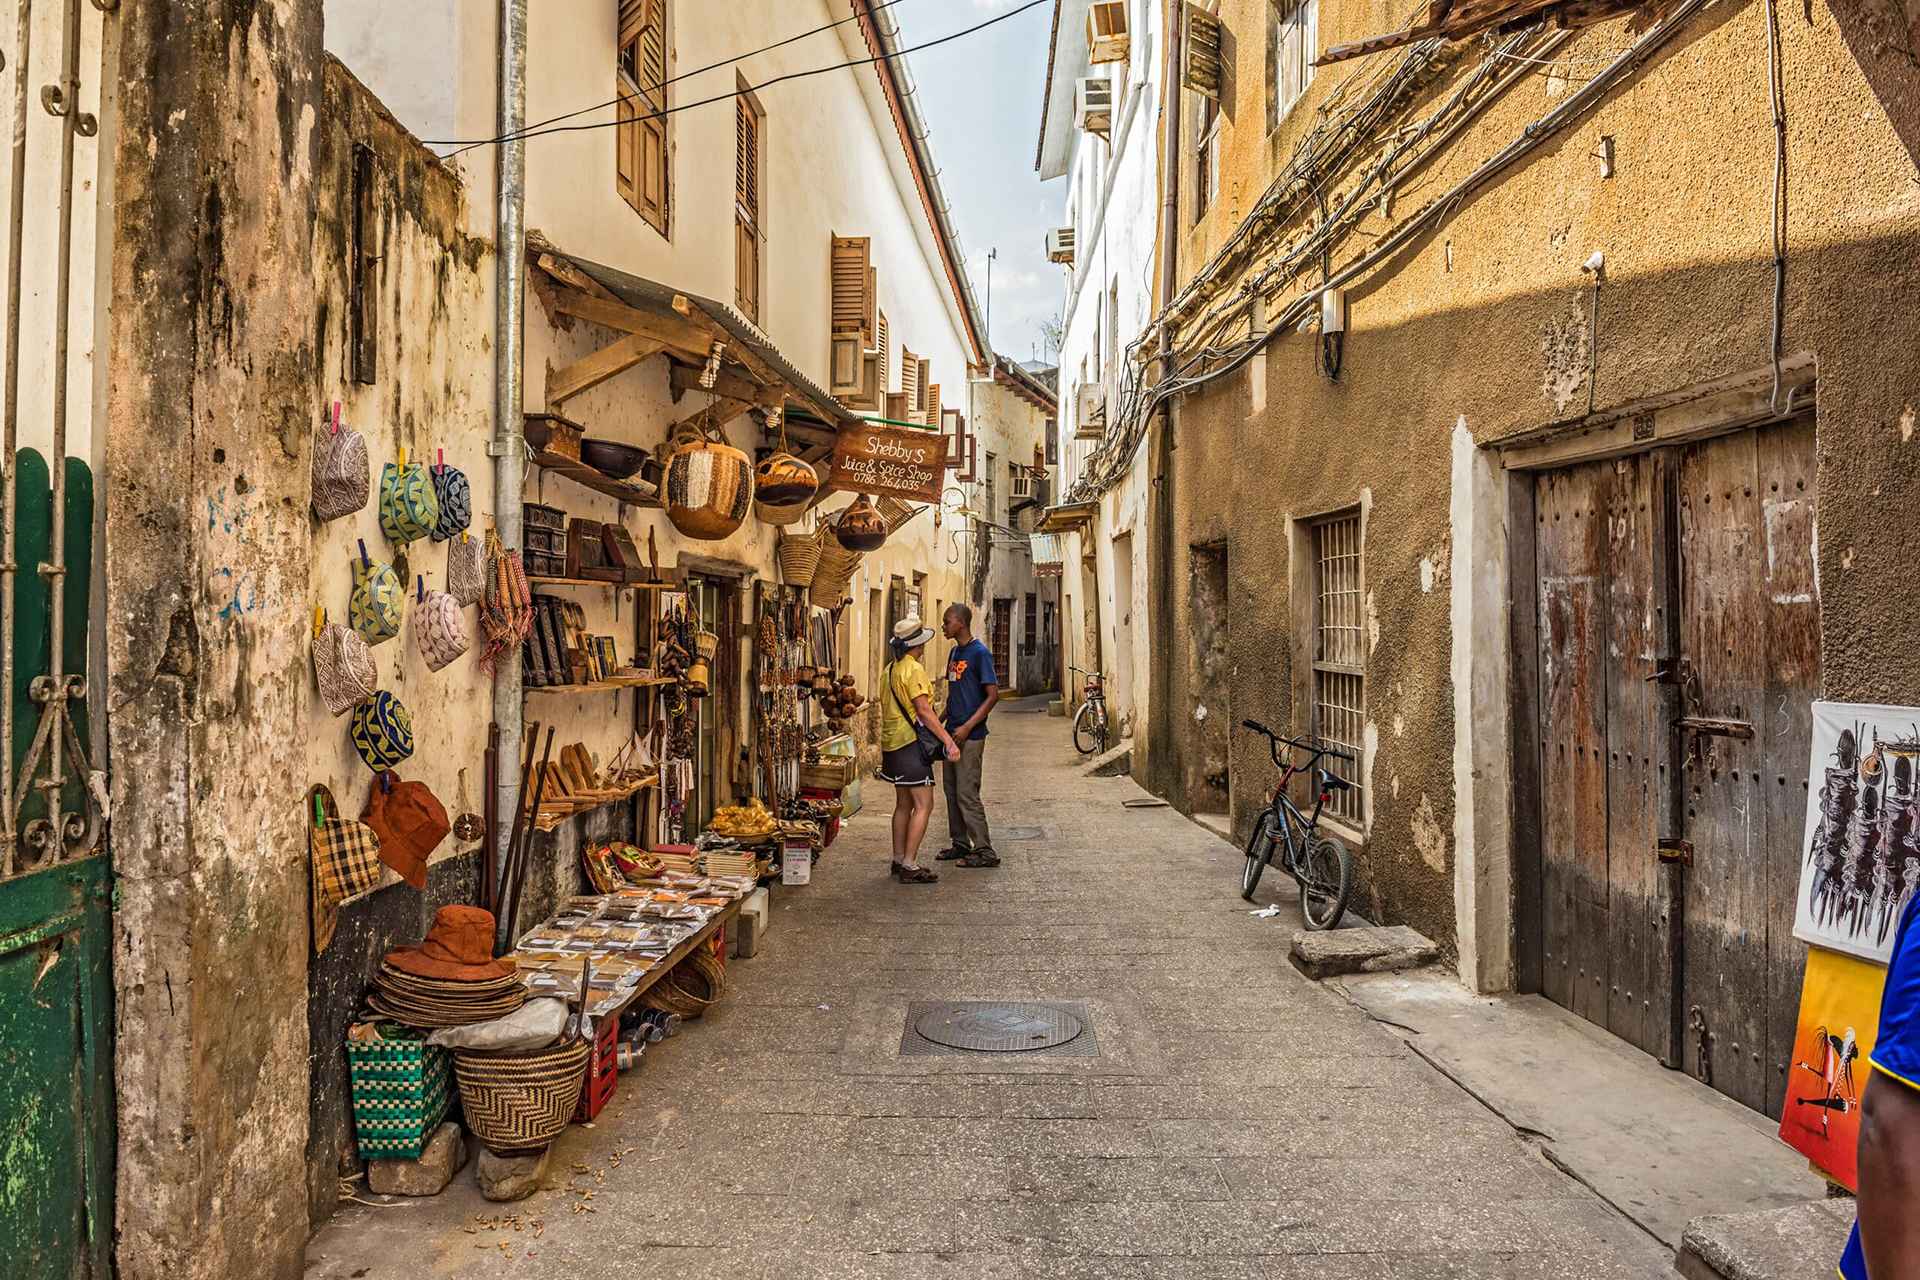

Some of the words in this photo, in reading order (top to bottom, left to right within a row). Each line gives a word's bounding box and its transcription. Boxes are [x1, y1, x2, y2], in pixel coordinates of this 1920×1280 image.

[841, 455, 866, 471] Juice
[866, 458, 877, 474] &
[879, 460, 905, 477] Spice
[907, 464, 933, 485] Shop
[853, 472, 876, 484] 0786
